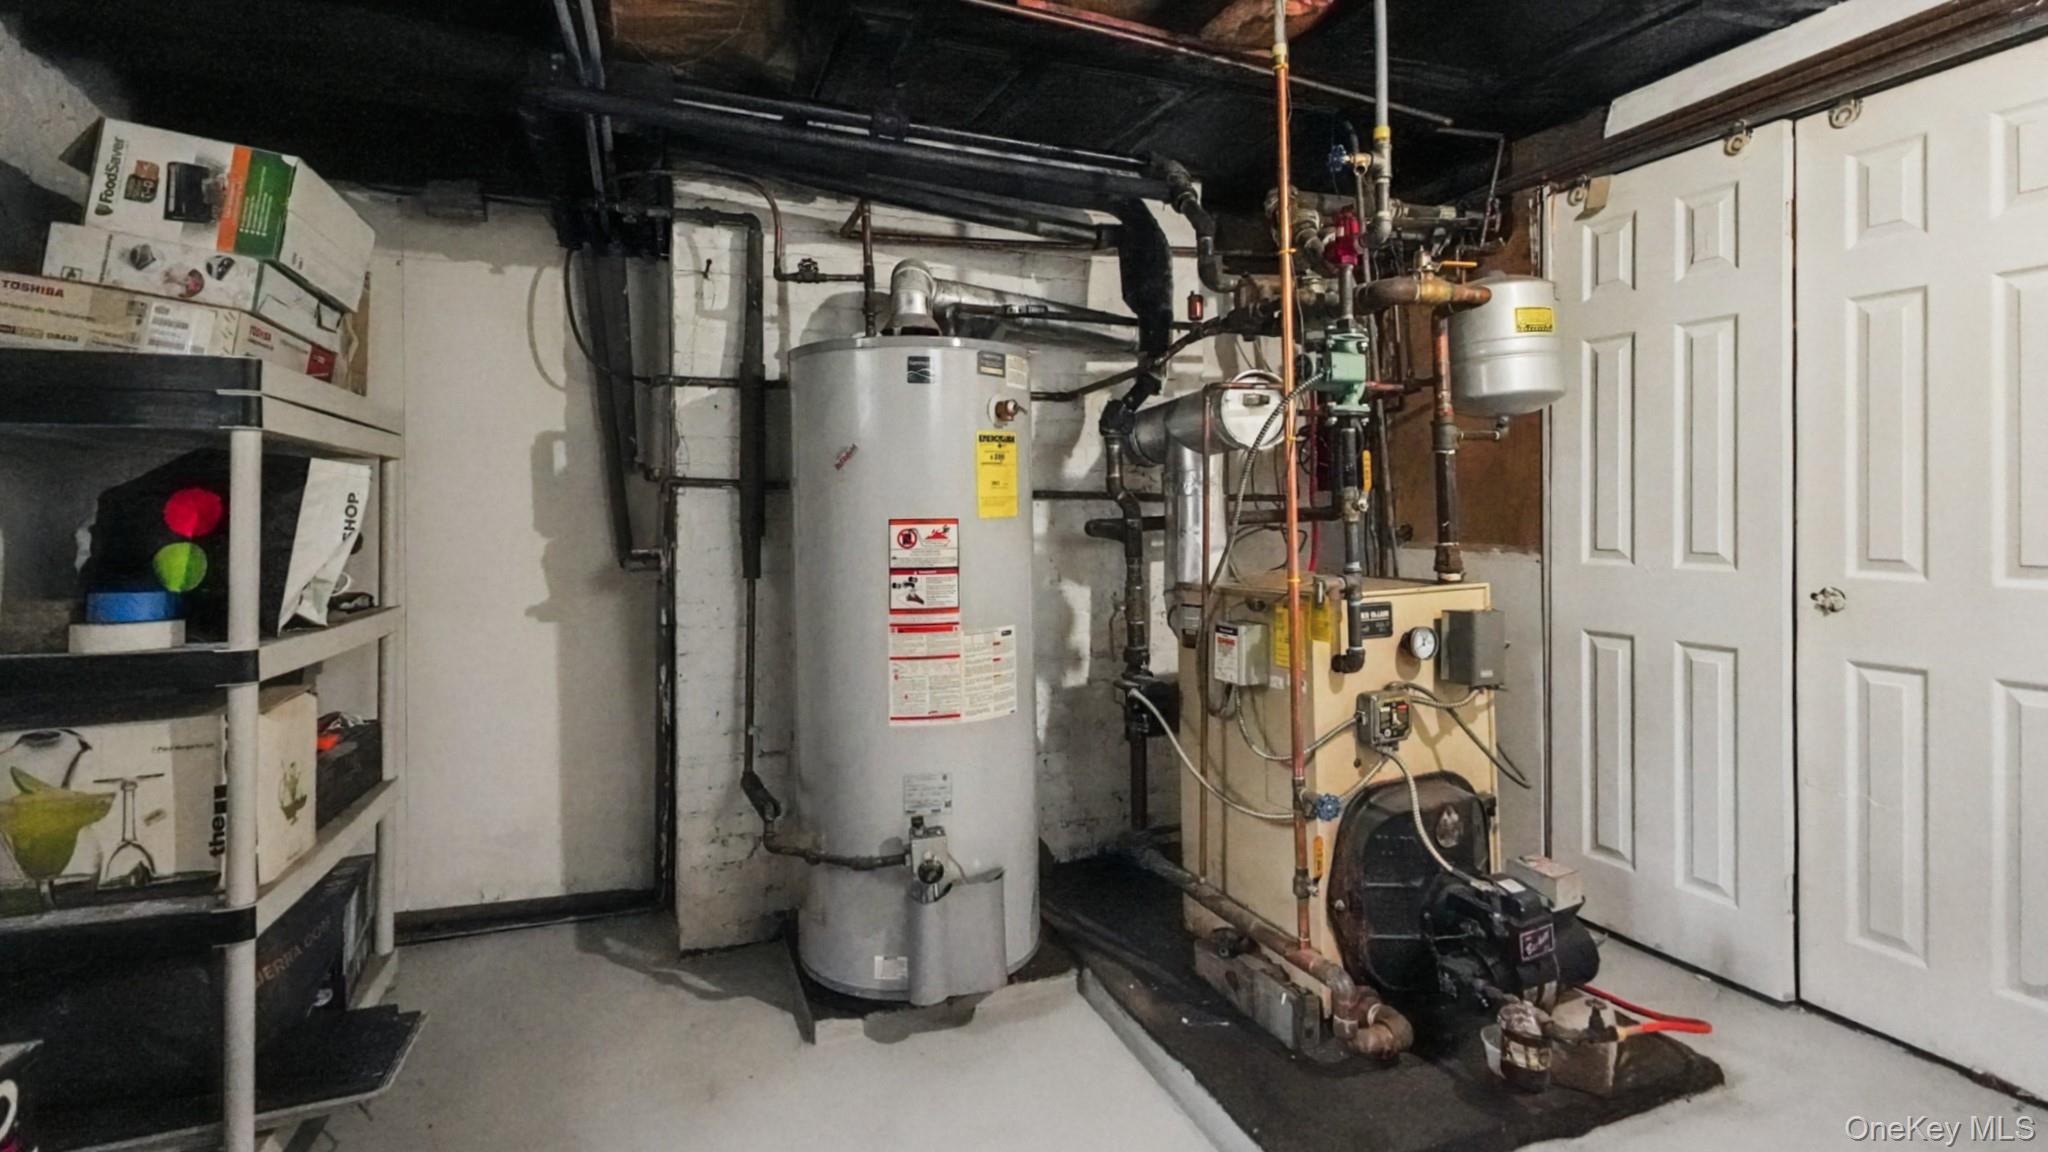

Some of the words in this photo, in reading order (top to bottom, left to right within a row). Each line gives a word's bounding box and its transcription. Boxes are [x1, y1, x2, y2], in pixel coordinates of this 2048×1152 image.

[99, 136, 125, 204] FoodSaver
[2, 279, 65, 298] TOSHIBA
[208, 815, 226, 858] the
